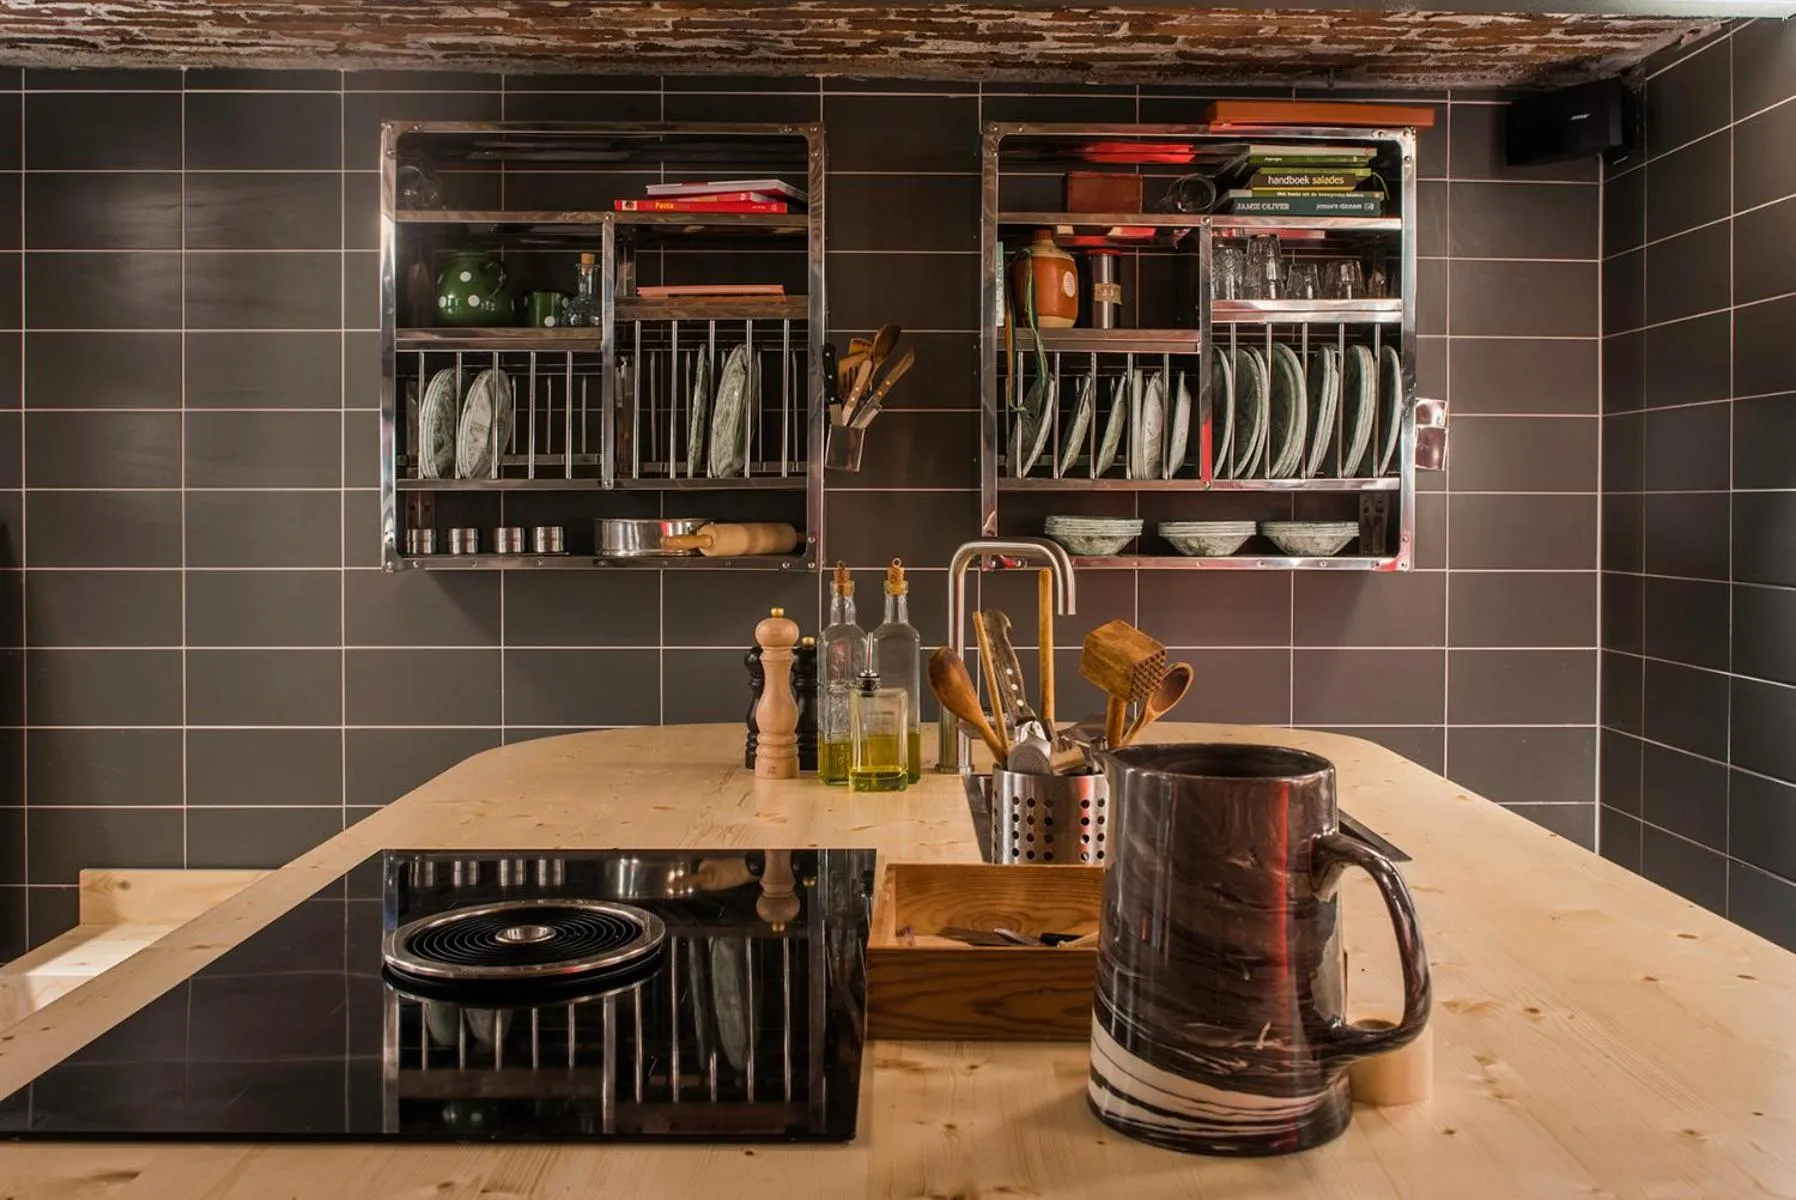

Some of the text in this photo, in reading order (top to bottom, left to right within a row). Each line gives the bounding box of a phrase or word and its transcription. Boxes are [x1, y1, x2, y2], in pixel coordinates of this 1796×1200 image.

[1267, 175, 1345, 184] handboek salades
[655, 202, 675, 210] Pasta
